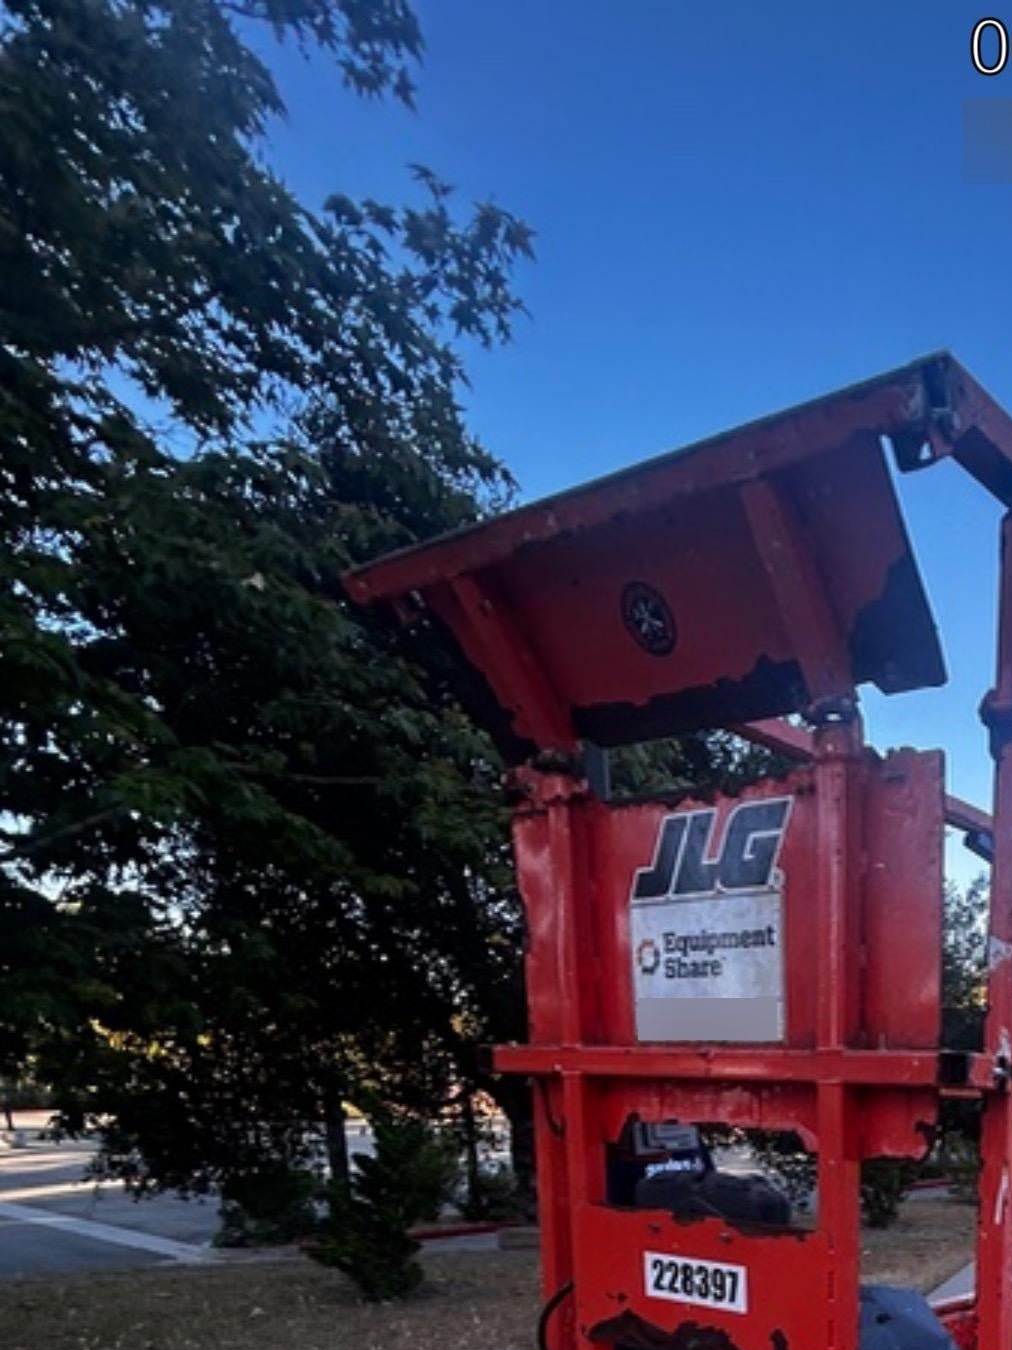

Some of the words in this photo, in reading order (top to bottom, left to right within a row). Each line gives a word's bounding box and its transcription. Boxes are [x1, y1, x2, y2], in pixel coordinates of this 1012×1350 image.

[632, 796, 793, 902] JLG
[663, 925, 775, 957] Equipment
[664, 957, 723, 979] Share
[652, 1258, 738, 1303] 228397
